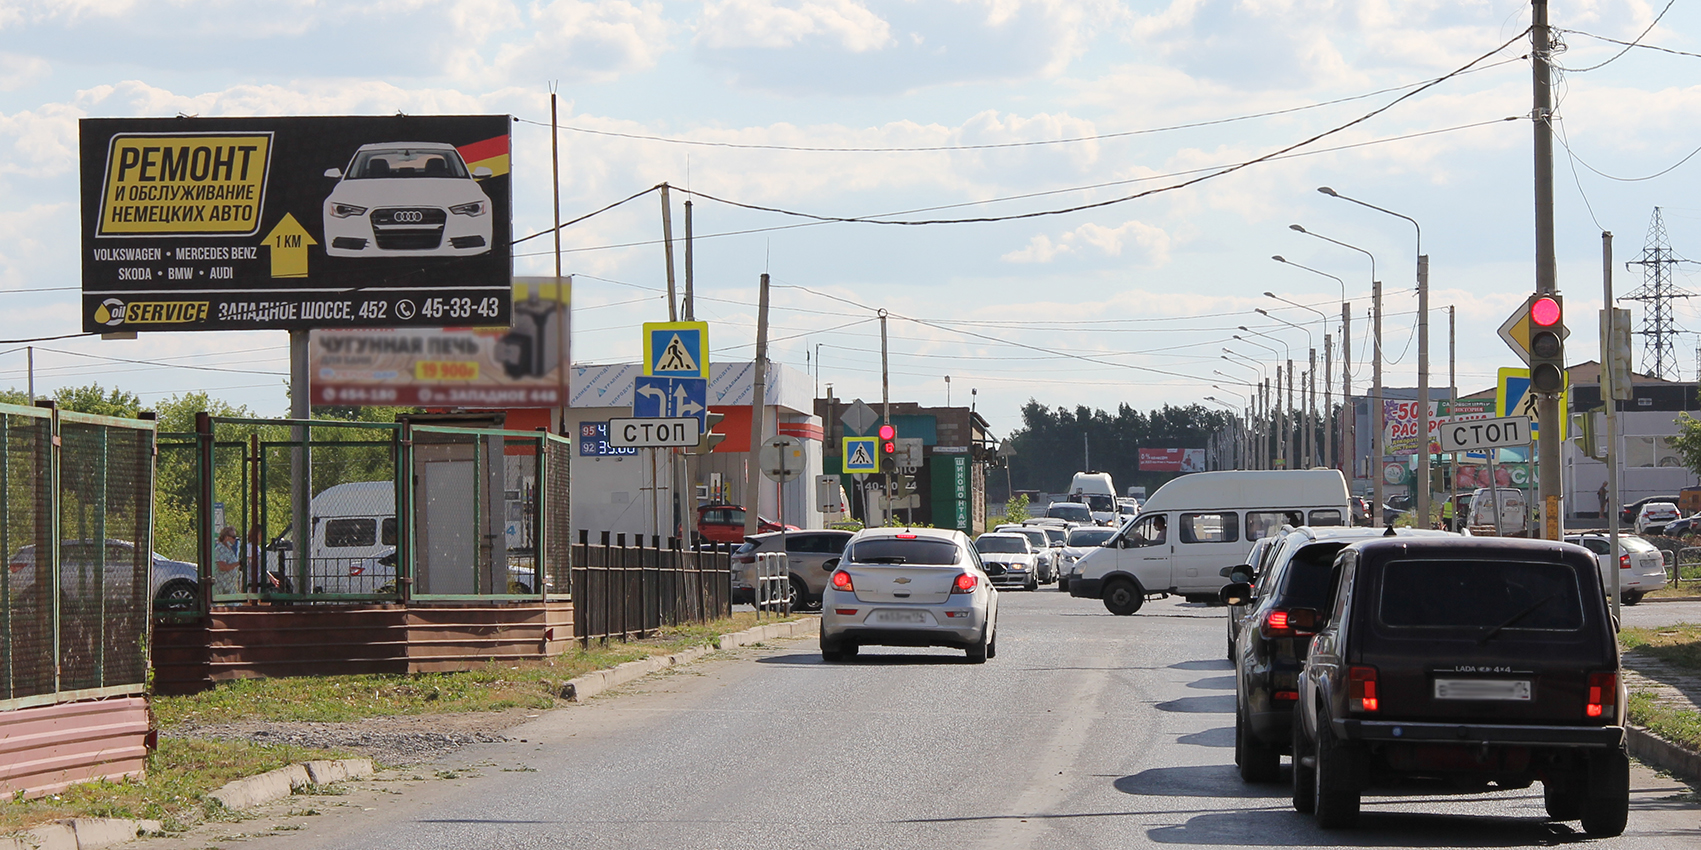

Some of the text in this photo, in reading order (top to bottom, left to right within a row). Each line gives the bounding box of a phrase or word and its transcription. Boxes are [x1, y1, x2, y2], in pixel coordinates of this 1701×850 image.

[117, 146, 257, 182] РЕМОНТ
[114, 184, 255, 201] И ОБСЛУЖИВАНИЕ
[111, 205, 253, 223] НЕМЕЦКИХ АВТО
[275, 235, 281, 248] 1
[94, 247, 257, 261] VOLKSWAGEN MERCEDES BENZ
[118, 267, 234, 280] SKODA BMW AUDI
[128, 303, 207, 322] SERVICE
[218, 298, 499, 321] ЗАПАДНОЕ ШОССЕ, 452 45-33-43
[318, 335, 480, 355] ЧУГУННАЯ ПЕЧЬ
[421, 363, 437, 376] 19
[583, 426, 595, 436] 95
[623, 422, 686, 443] СТОП
[1453, 421, 1519, 446] СТОП
[583, 443, 595, 453] 92
[954, 457, 967, 528] ШИНОМОНТАЖ
[506, 525, 516, 535] 4
[1455, 665, 1476, 673] LADA
